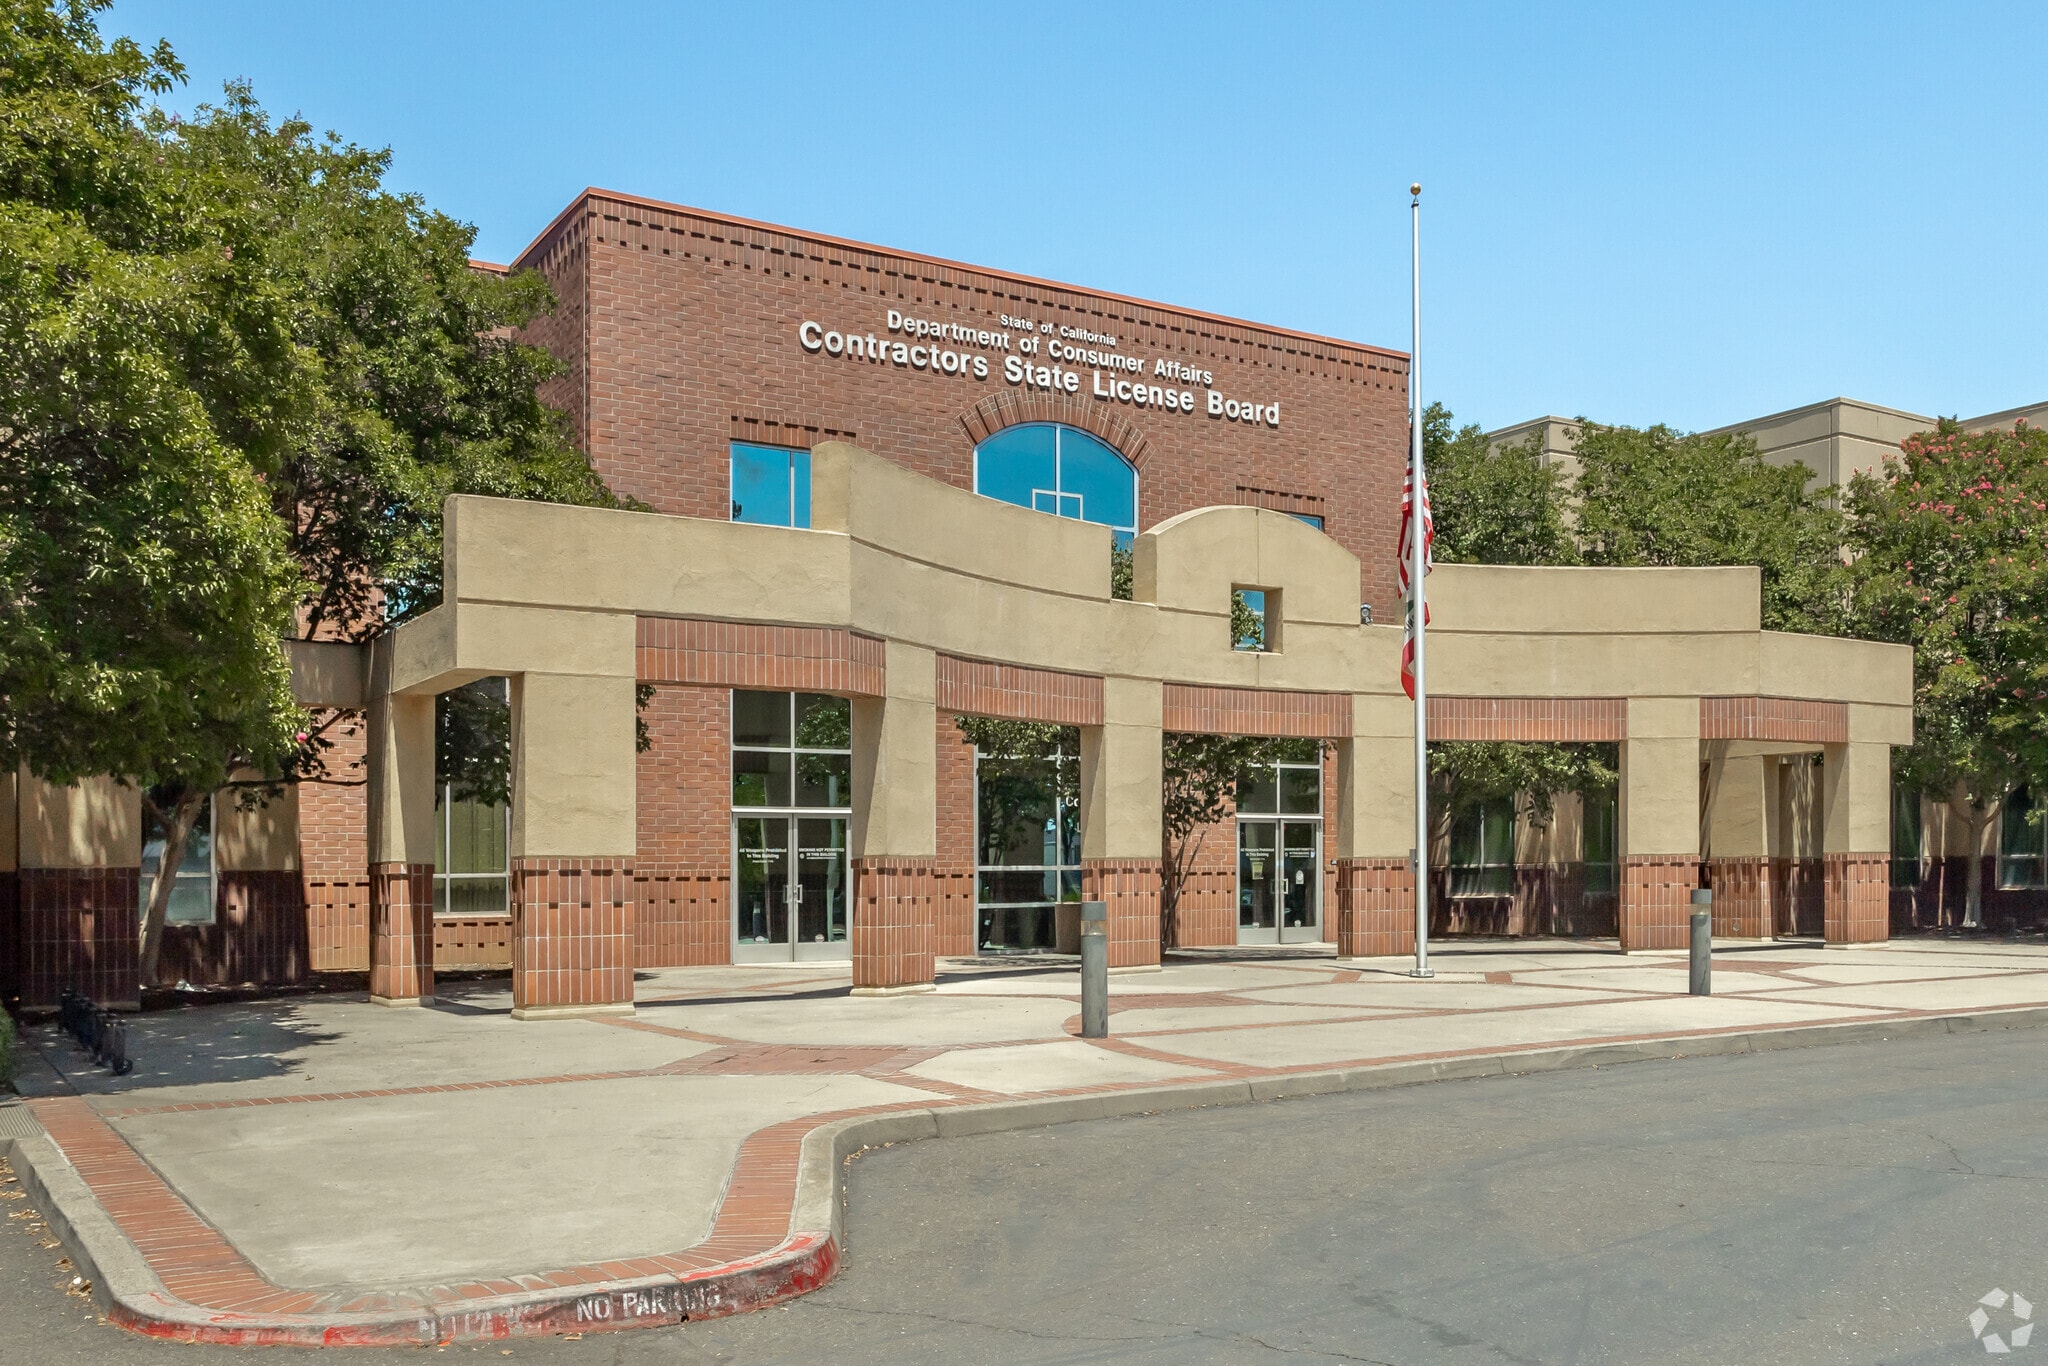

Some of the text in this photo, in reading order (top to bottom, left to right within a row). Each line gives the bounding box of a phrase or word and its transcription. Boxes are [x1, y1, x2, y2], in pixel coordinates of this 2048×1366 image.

[887, 309, 1213, 385] Department of Consumer Affairs
[1000, 314, 1117, 346] State of California
[799, 320, 1280, 425] Contractors State License Board
[576, 1296, 611, 1322] NO
